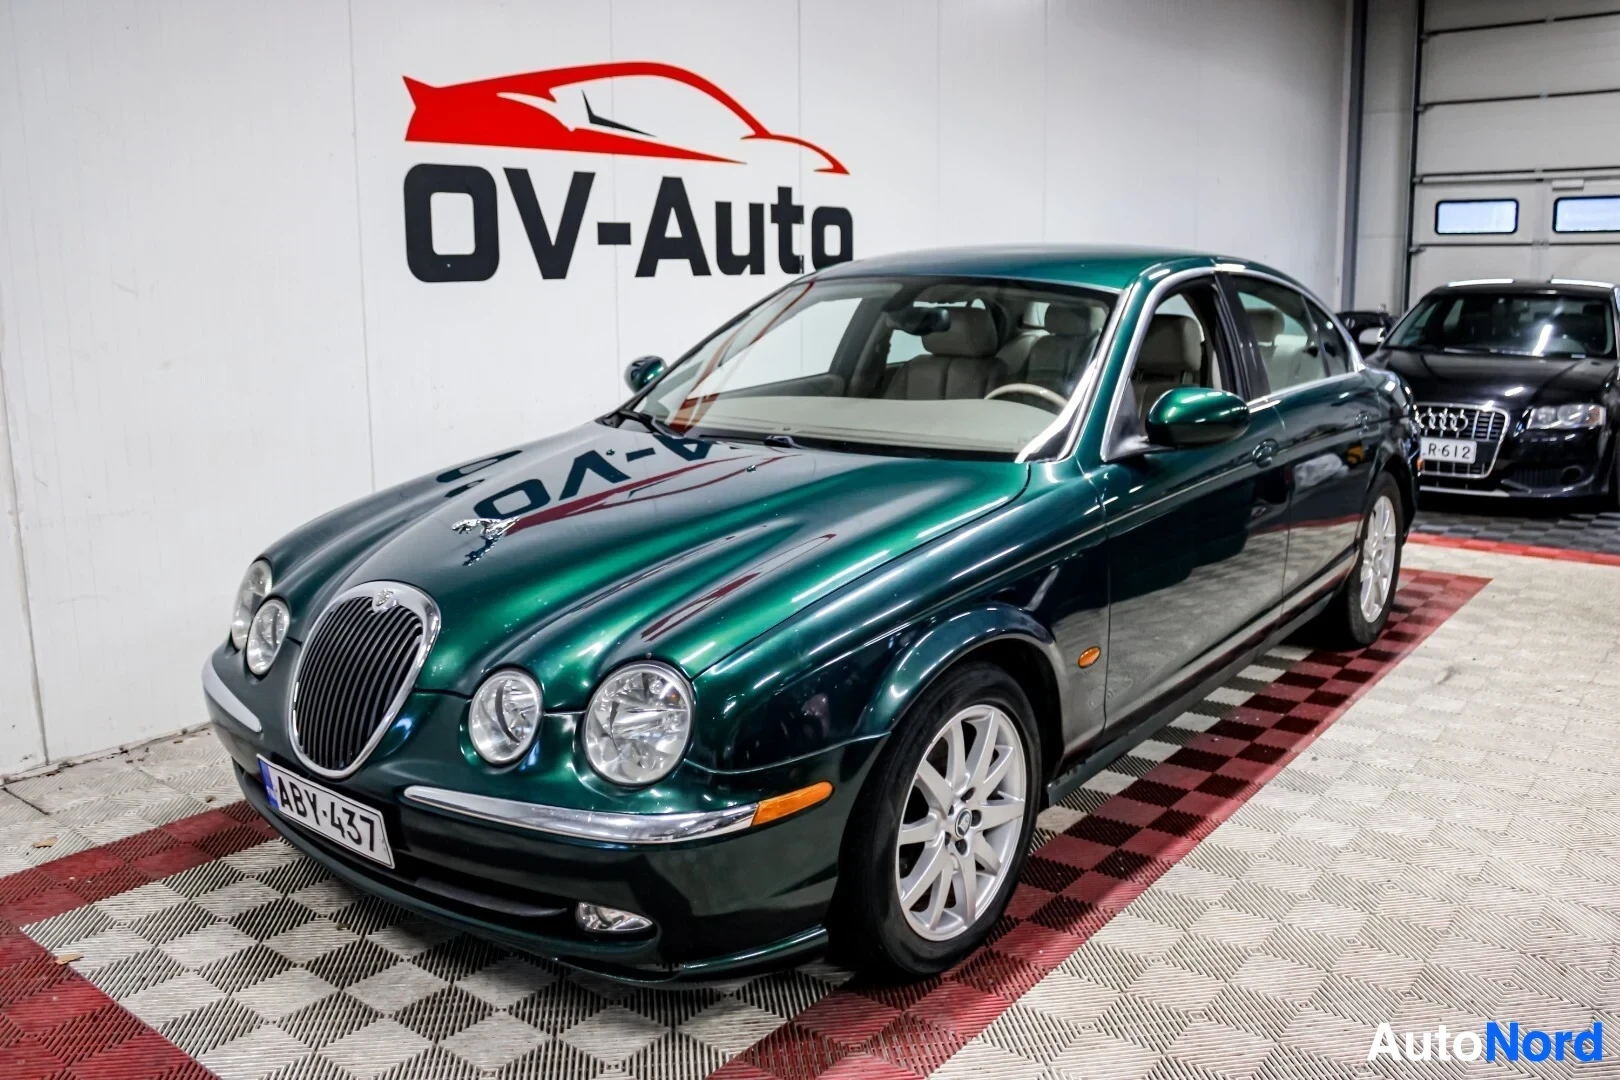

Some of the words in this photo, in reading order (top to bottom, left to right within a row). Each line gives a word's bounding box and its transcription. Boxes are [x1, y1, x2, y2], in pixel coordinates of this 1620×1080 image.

[404, 163, 853, 283] OV-Auto
[1423, 442, 1471, 459] R-612
[277, 775, 375, 853] ABY-437
